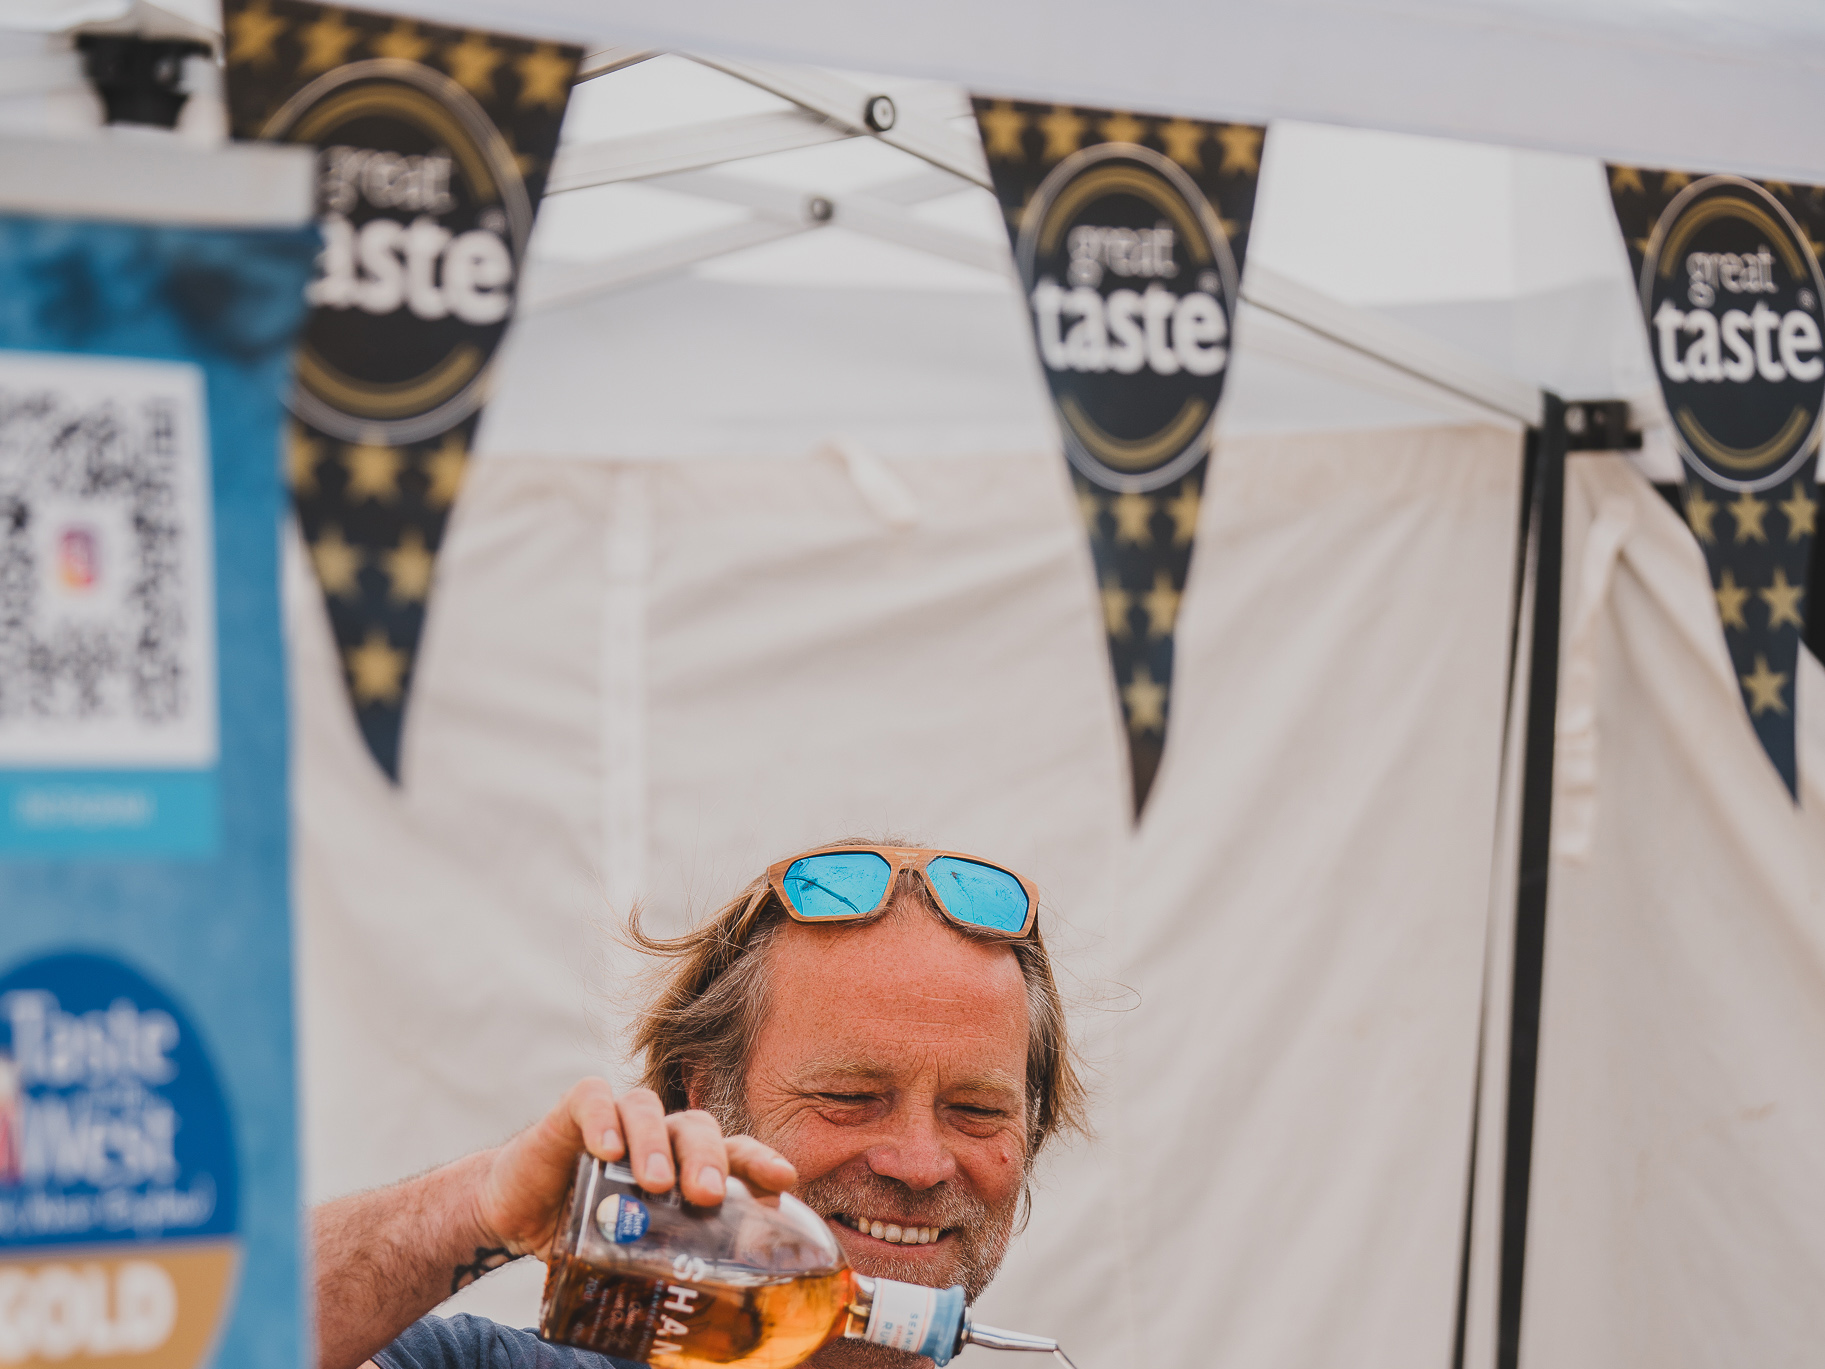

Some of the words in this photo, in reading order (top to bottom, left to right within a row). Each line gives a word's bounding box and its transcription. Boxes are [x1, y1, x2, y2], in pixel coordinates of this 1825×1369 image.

[1067, 224, 1178, 288] great
[1686, 245, 1778, 308] great
[1033, 278, 1229, 376] taste
[1653, 299, 1824, 383] taste
[0, 1260, 177, 1363] GOLD
